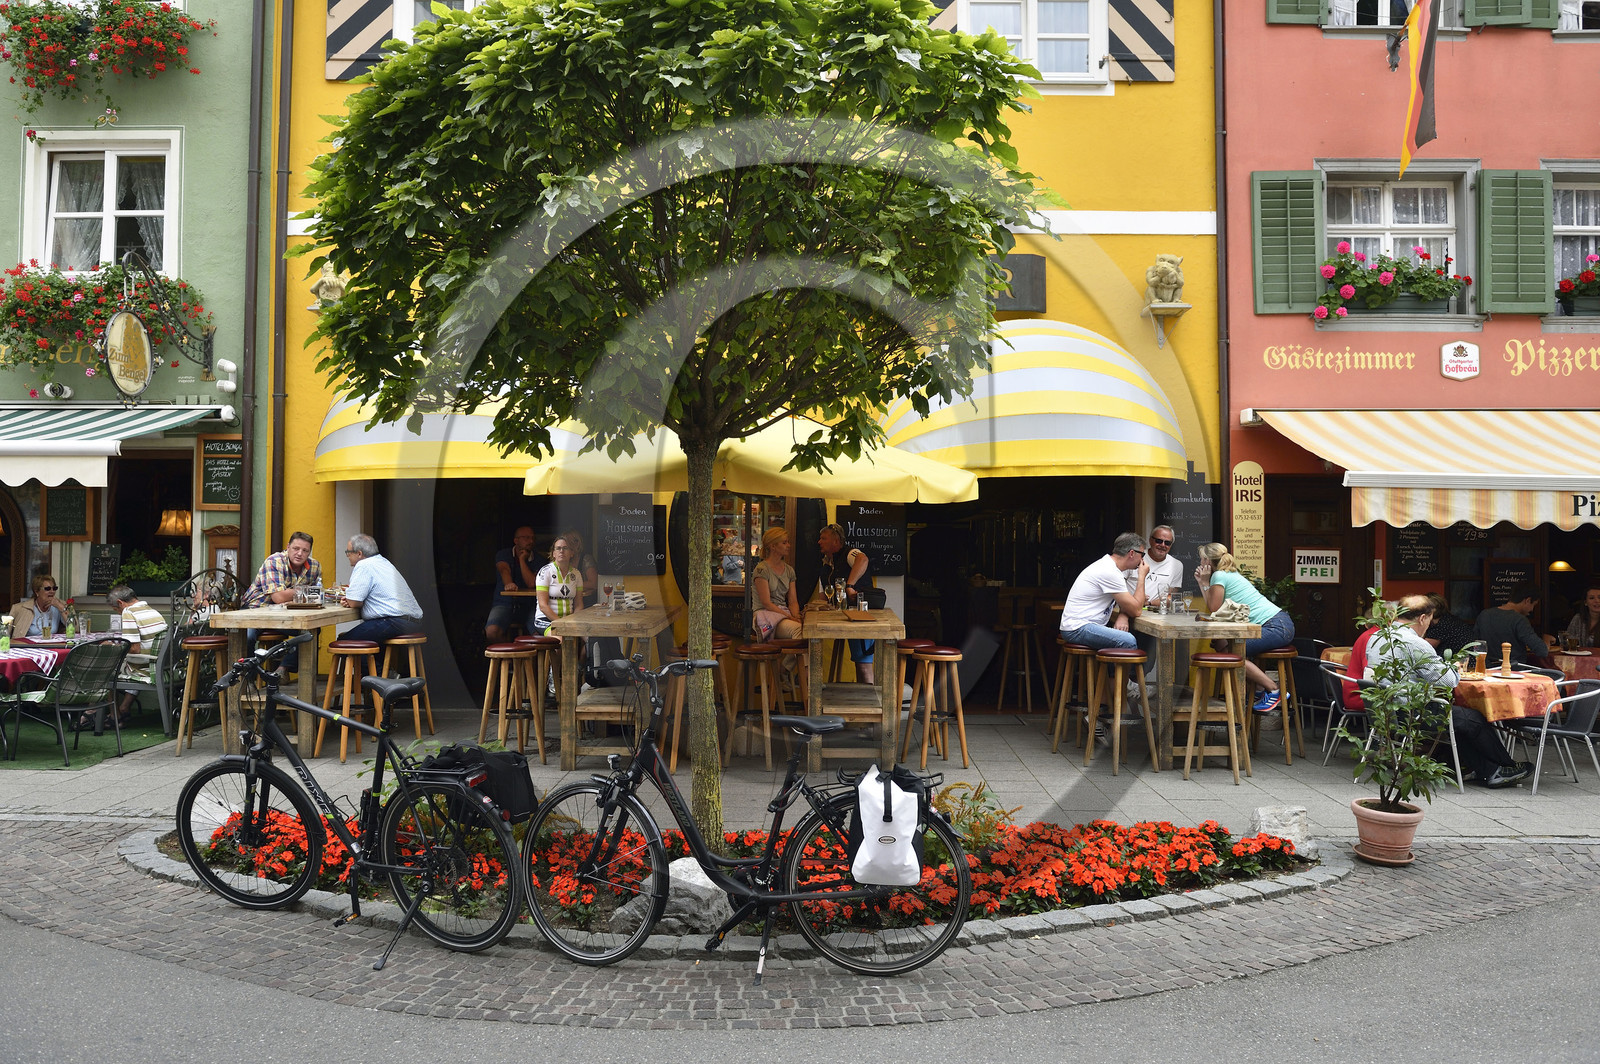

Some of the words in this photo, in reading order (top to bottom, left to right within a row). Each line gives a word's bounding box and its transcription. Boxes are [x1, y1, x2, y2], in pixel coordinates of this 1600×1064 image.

[109, 347, 128, 362] Zum
[1263, 344, 1416, 374] Gästezimmer
[119, 364, 146, 383] Bengel
[1444, 364, 1478, 373] Hofbräu
[1234, 474, 1262, 486] Hotel
[1235, 489, 1262, 502] IRIS
[619, 506, 648, 516] Baden
[858, 506, 884, 515] Baden
[1571, 494, 1600, 517] Pi
[606, 519, 654, 533] Hauswein
[847, 521, 898, 537] Hauswein
[1296, 555, 1338, 566] ZIMMER
[1300, 567, 1334, 577] FREI
